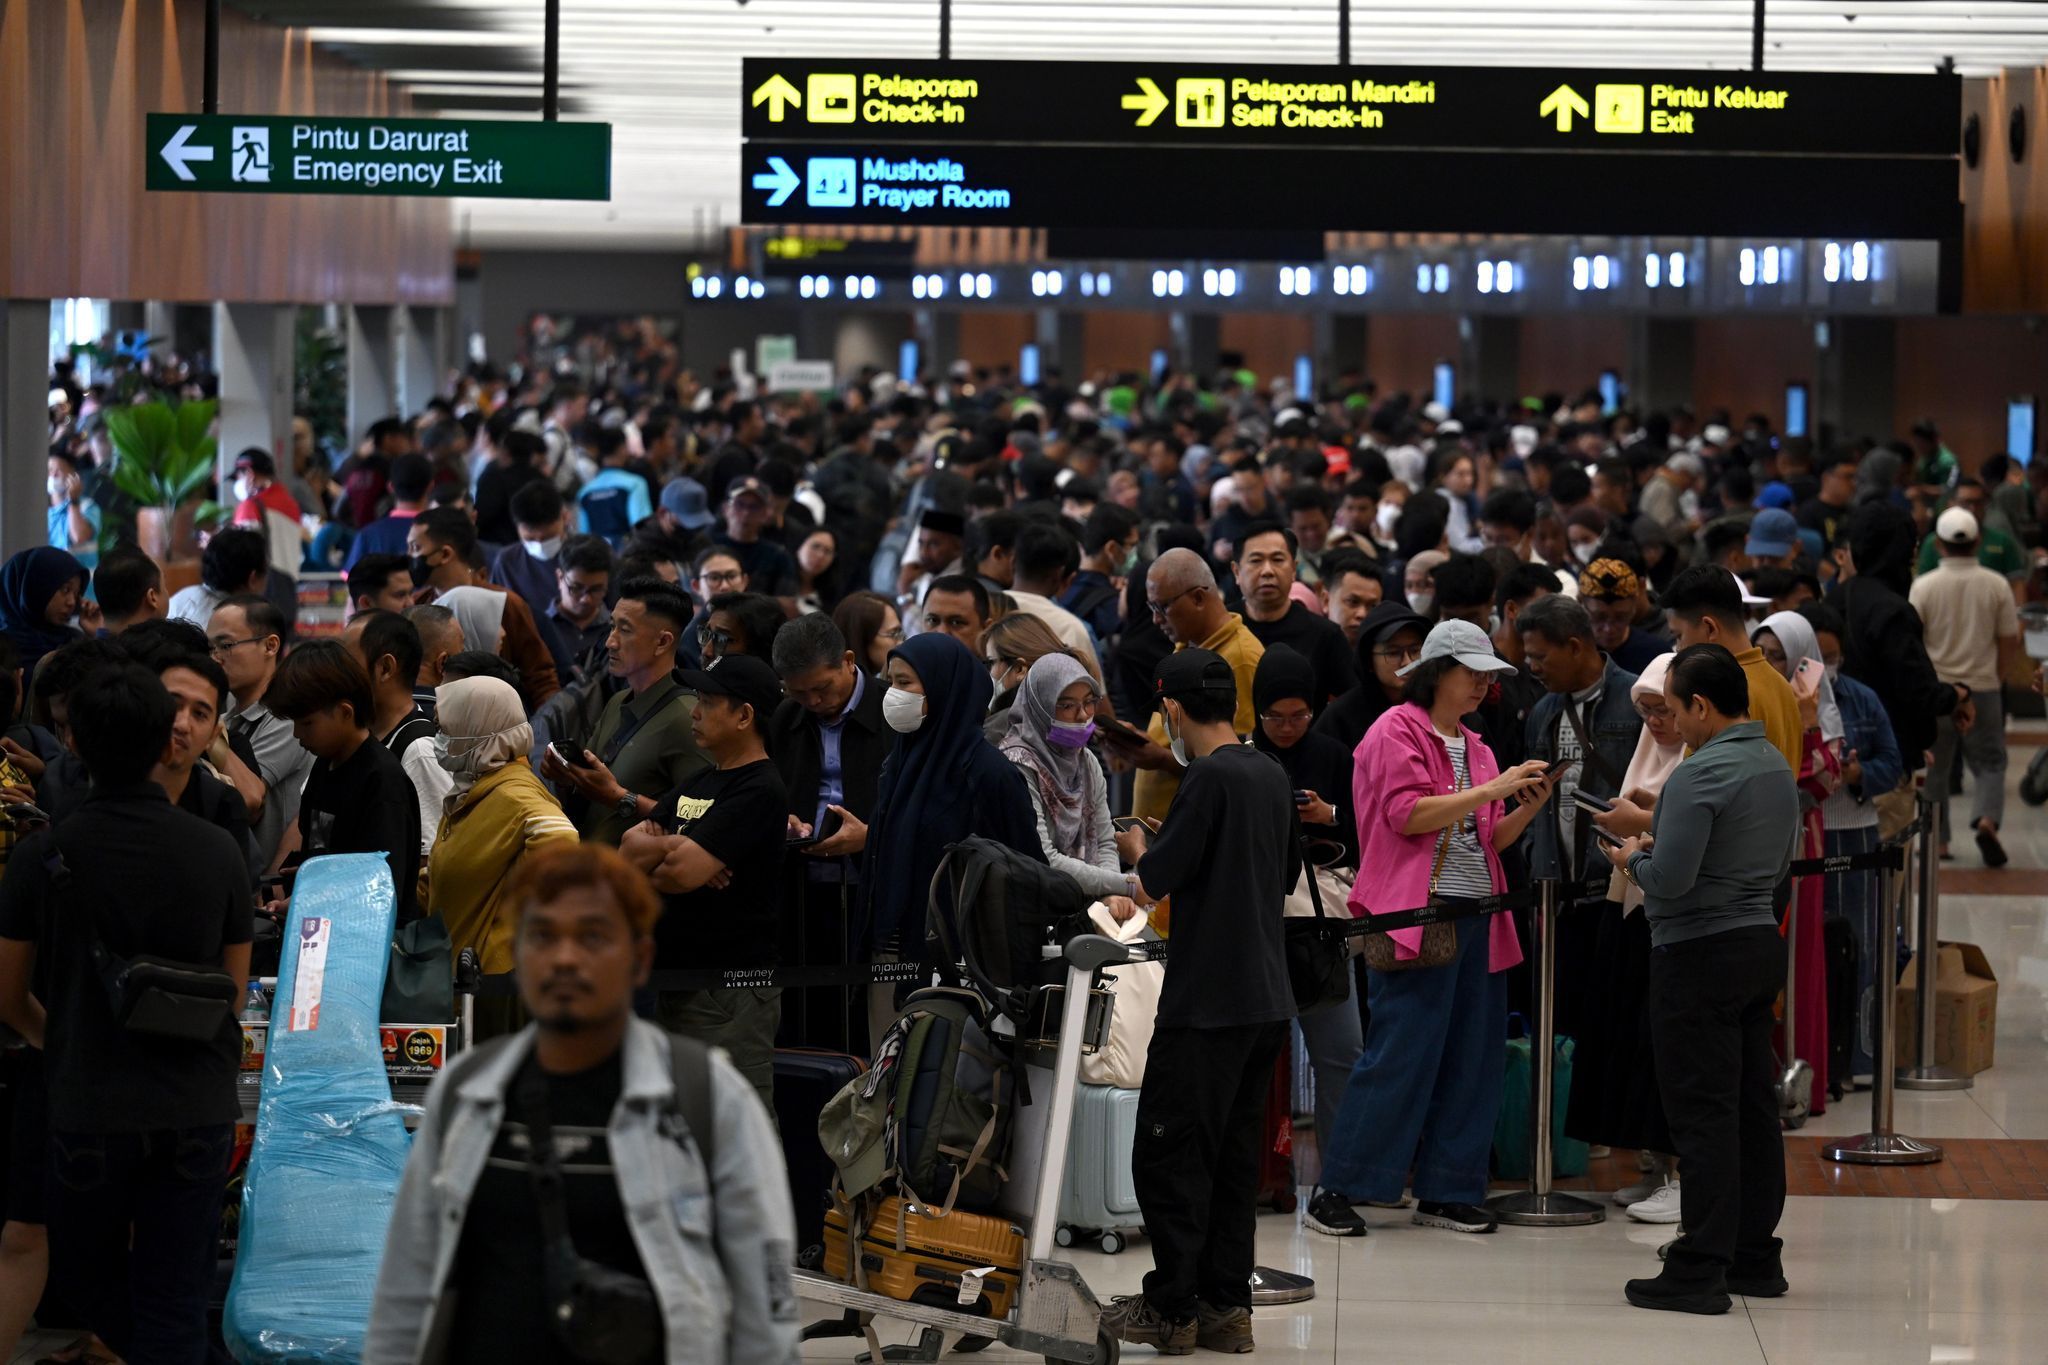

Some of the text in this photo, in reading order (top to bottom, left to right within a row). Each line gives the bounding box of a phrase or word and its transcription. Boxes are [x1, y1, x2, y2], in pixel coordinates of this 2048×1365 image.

[863, 74, 978, 102] Pelaporan
[1232, 79, 1435, 106] Pelaporan Mandiri
[1651, 84, 1788, 109] Pintu Keluar
[863, 99, 965, 123] Check-In
[1232, 103, 1383, 128] Self Check-In
[1650, 110, 1695, 133] Exit
[293, 125, 469, 151] Pintu Darurat
[293, 155, 503, 188] Emergency Exit
[863, 157, 965, 182] Musholla
[863, 183, 1010, 212] Prayer Room
[723, 969, 774, 981] injourney
[872, 962, 920, 975] injourney
[726, 980, 772, 988] AIRPORTS
[409, 1046, 433, 1056] 1969
[411, 1037, 431, 1045] Sejak
